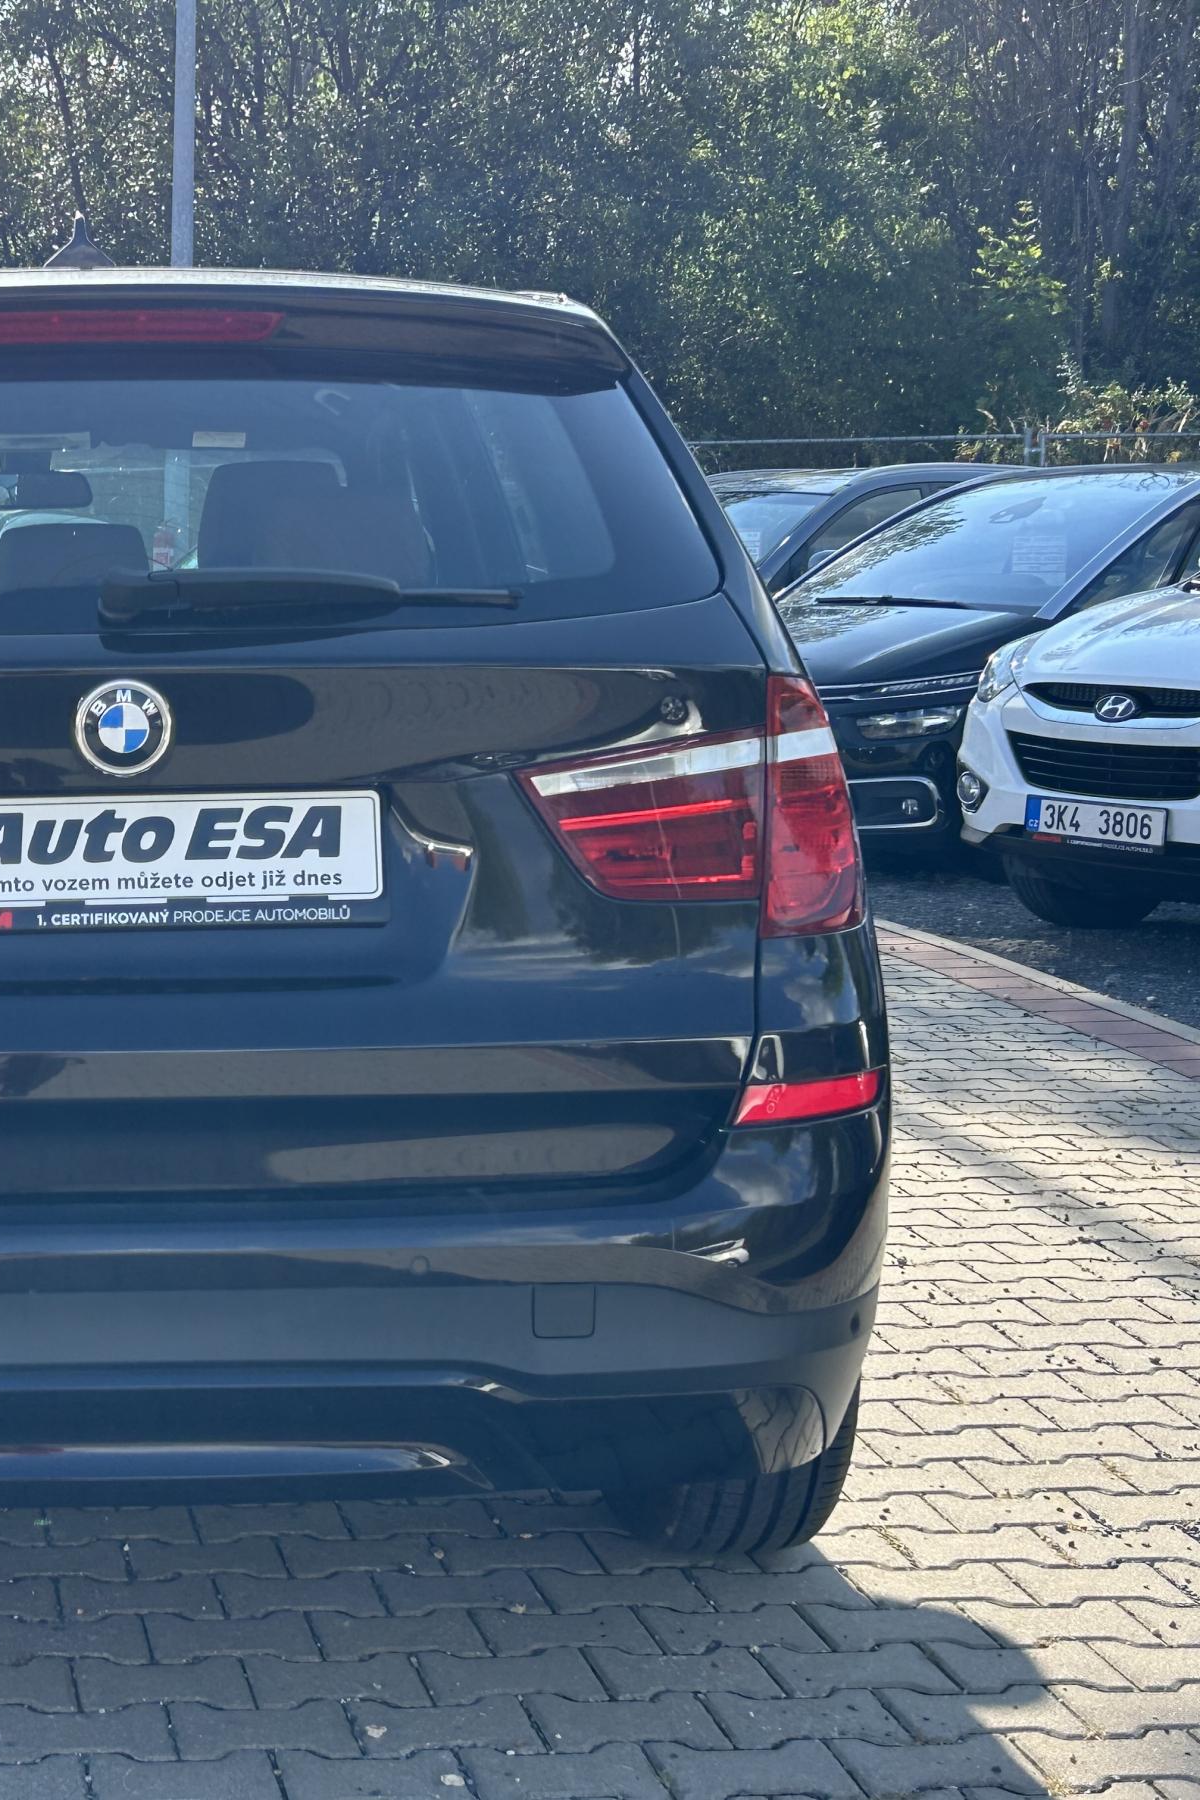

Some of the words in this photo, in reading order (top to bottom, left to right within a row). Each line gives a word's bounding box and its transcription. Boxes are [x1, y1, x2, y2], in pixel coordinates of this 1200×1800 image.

[90, 689, 158, 717] BMW
[184, 805, 342, 861] ESA
[1044, 804, 1081, 833] 3K4
[1098, 809, 1153, 840] 3806
[42, 877, 110, 892] vozem
[117, 871, 194, 890] můžete
[201, 871, 256, 891] odjet
[261, 870, 286, 890] již
[293, 870, 342, 887] dnes
[36, 914, 47, 927] 1.
[51, 908, 170, 927] CERTIFIKOVANÝ
[173, 909, 251, 924] PRODEJCE
[254, 904, 351, 922] AUTOMOBILŮ
